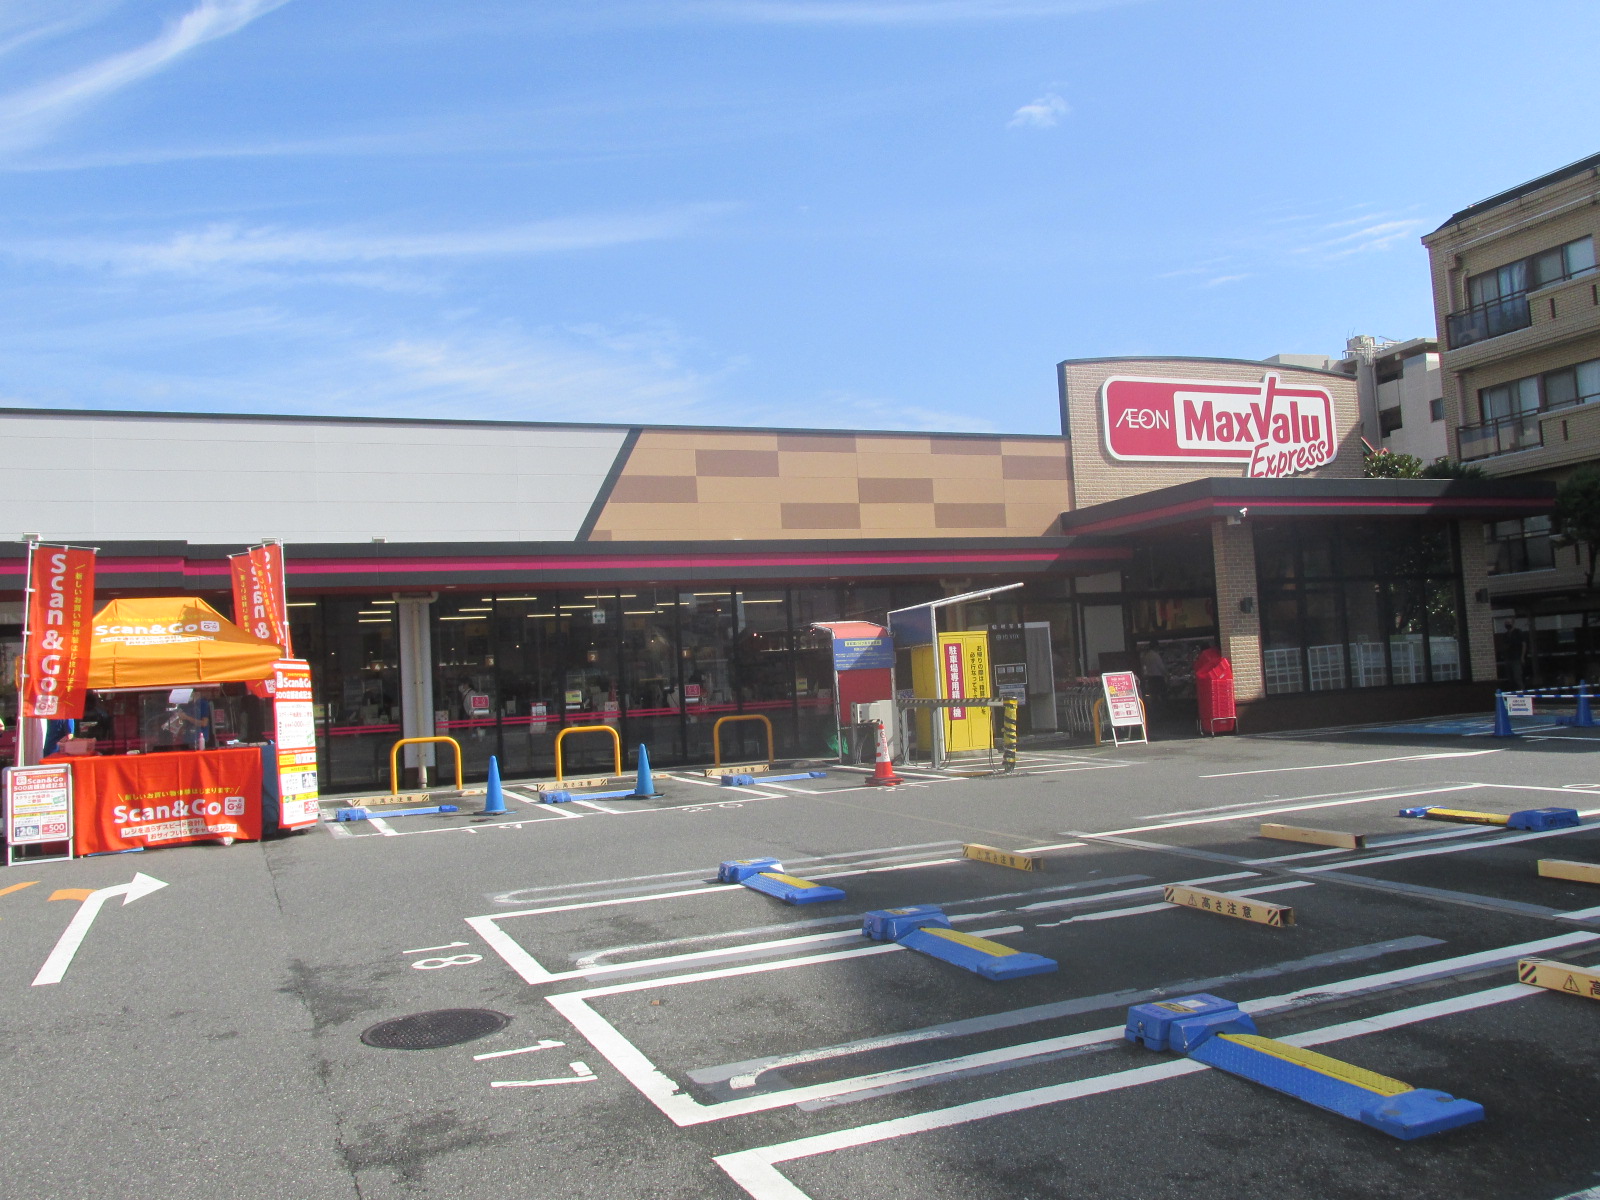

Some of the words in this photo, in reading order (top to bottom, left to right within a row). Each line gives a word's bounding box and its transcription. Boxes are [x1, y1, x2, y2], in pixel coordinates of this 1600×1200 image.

[1182, 376, 1321, 444] MaxValu
[1250, 440, 1327, 478] Express
[94, 622, 198, 636] Scan&Go
[948, 645, 962, 718] 駐車場専用精機
[561, 780, 592, 790] 高さ注意
[113, 798, 222, 824] Scan&Go
[984, 850, 1016, 867] 高さ注意
[1201, 896, 1252, 918] 高さ注意
[402, 941, 483, 970] 18
